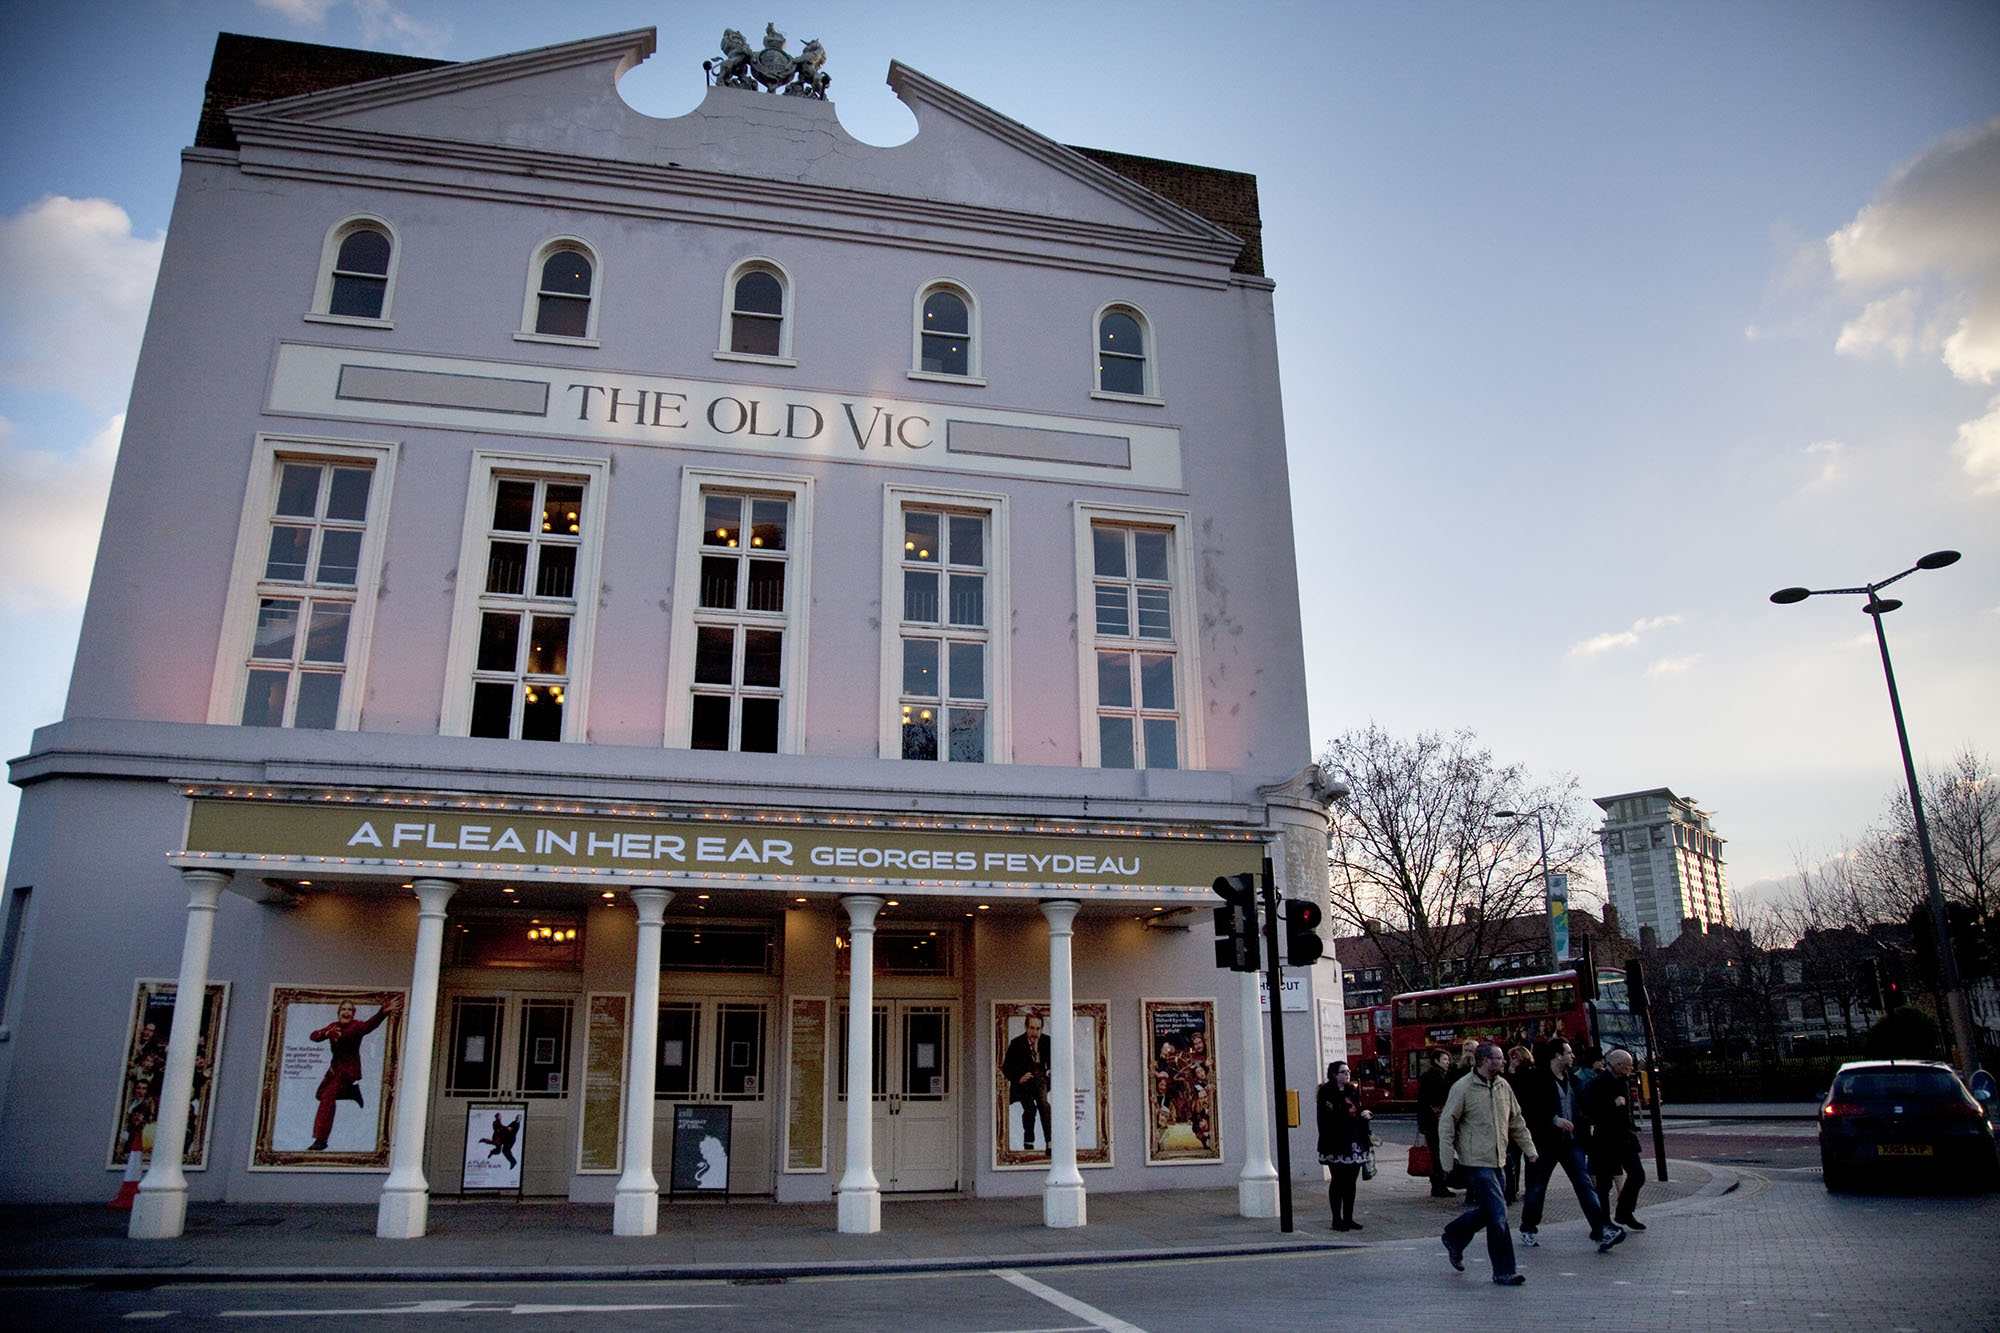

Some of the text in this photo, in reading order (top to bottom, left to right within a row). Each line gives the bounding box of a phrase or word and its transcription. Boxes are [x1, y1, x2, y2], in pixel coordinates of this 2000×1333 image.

[567, 384, 688, 429] THE
[706, 396, 825, 440] OLD
[347, 821, 1141, 875] A FLEA IN HER EAR GEORGES FEYDEAU
[1260, 981, 1272, 991] HE
